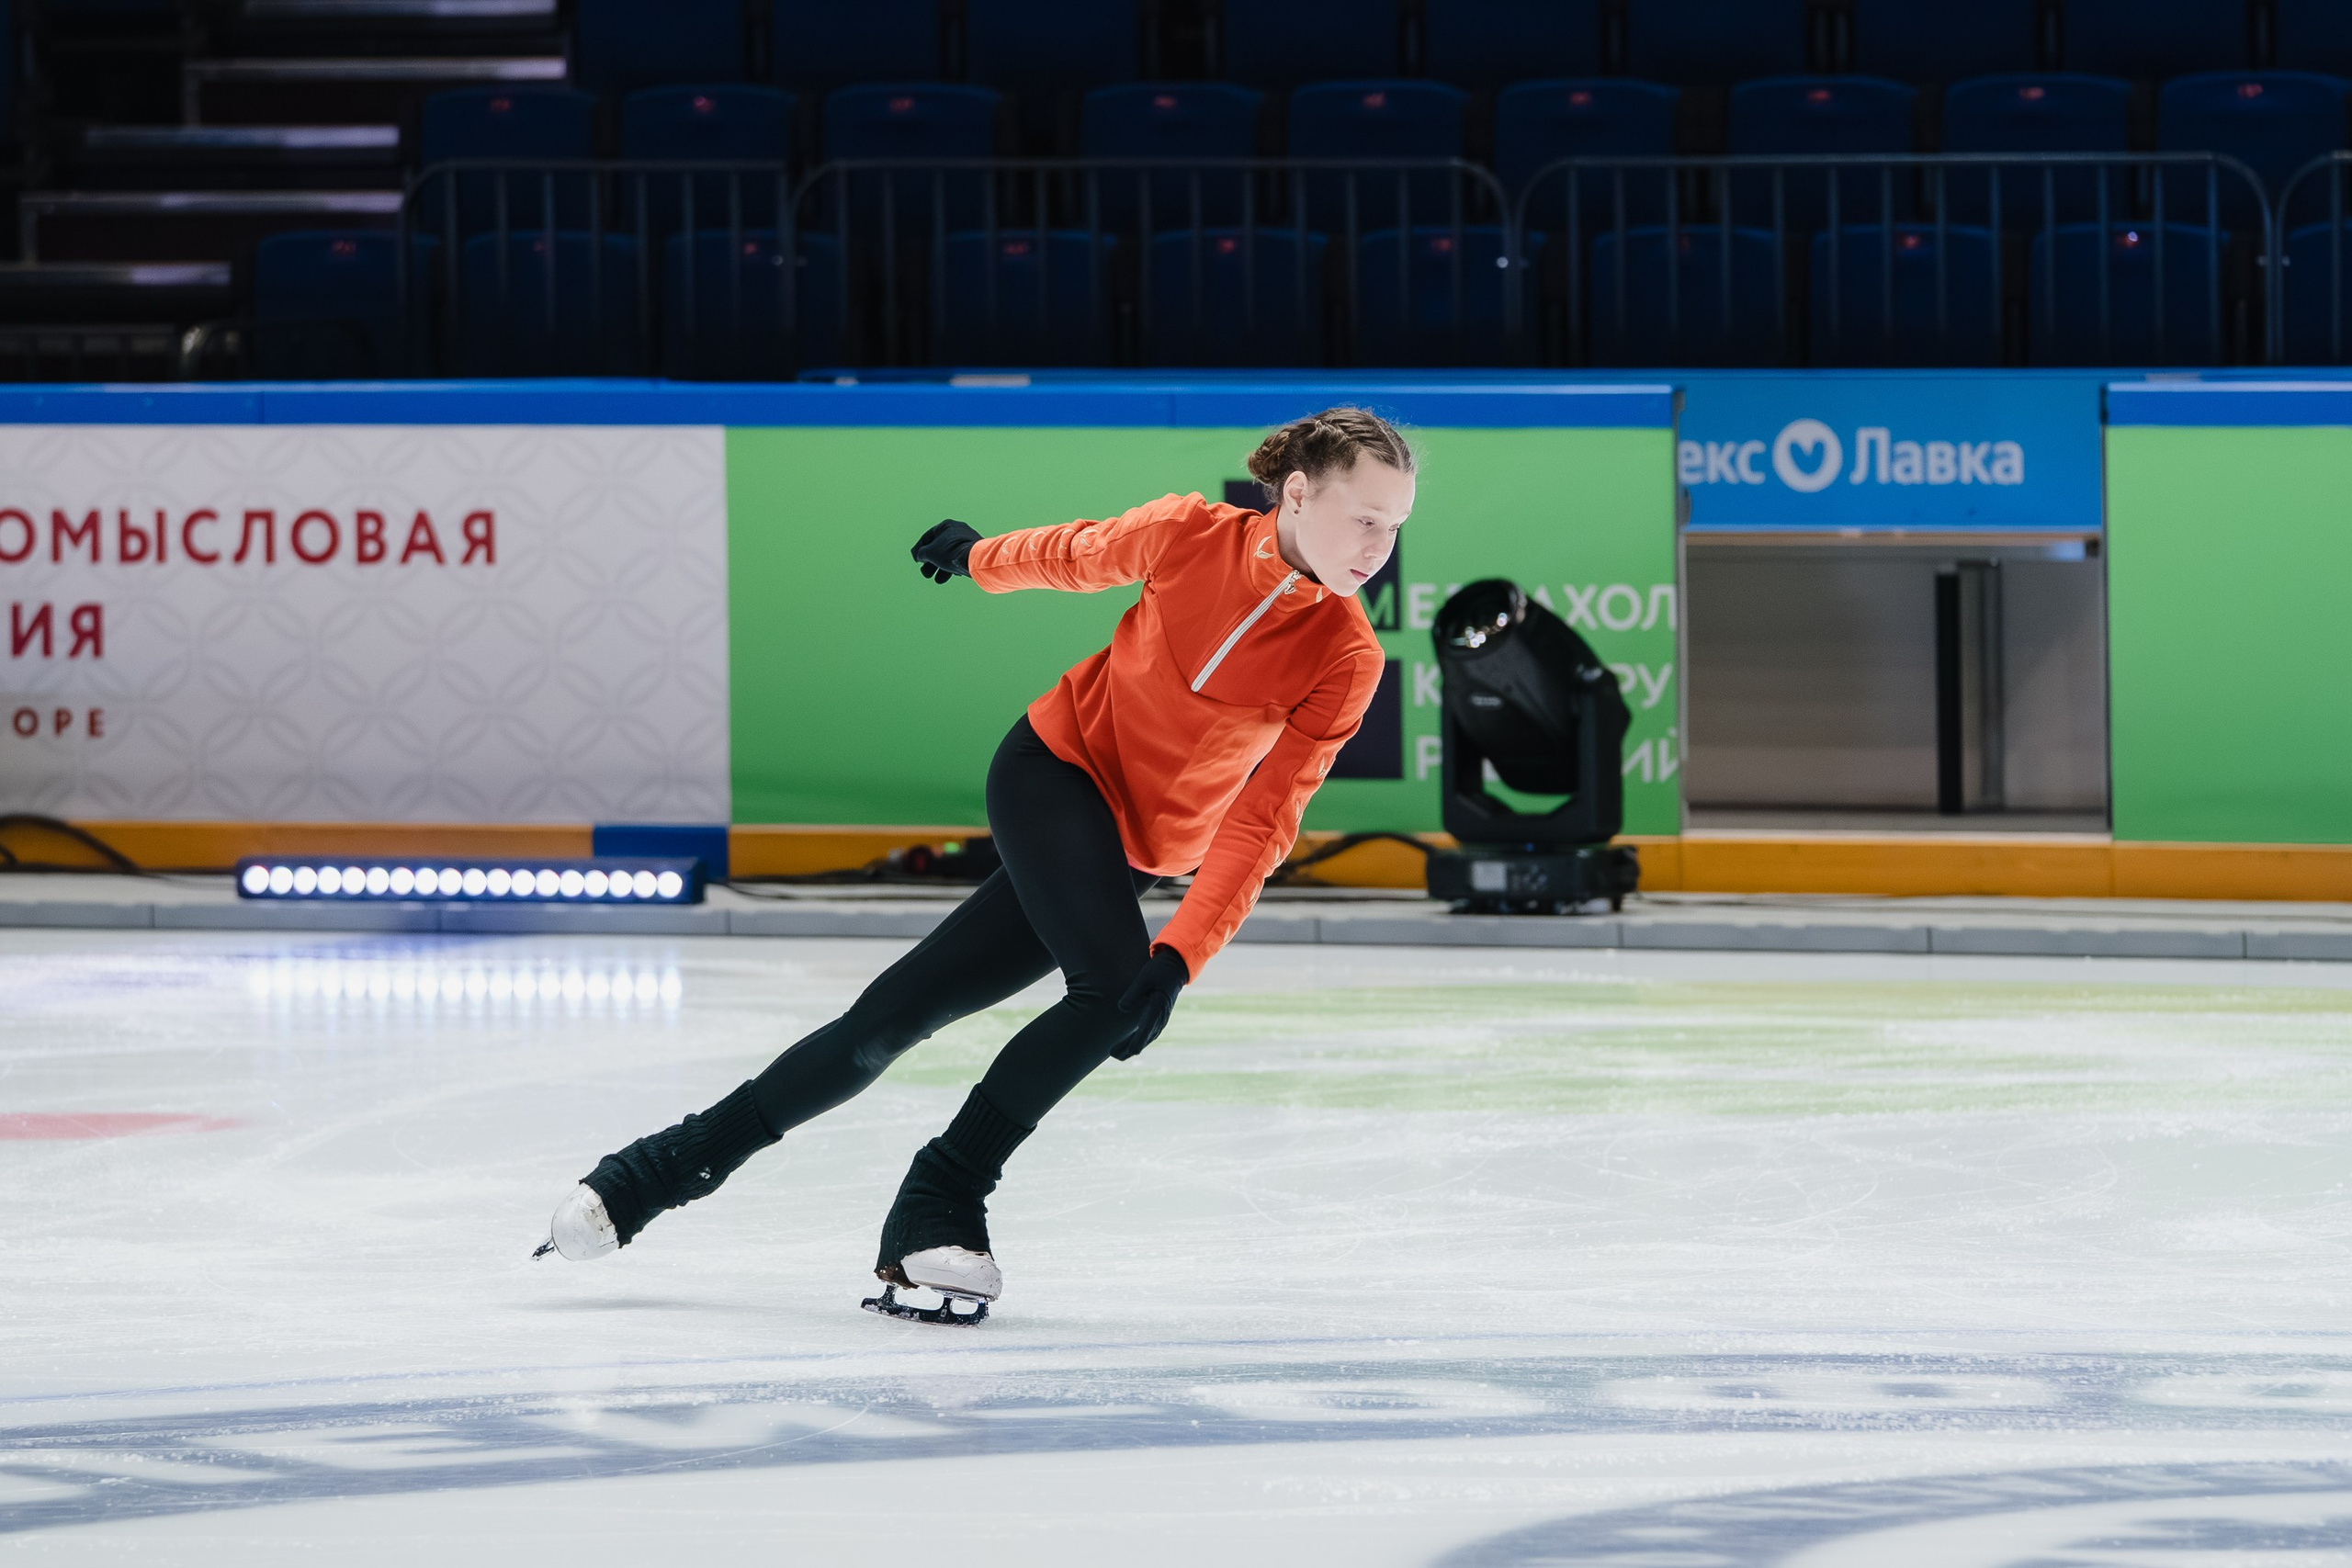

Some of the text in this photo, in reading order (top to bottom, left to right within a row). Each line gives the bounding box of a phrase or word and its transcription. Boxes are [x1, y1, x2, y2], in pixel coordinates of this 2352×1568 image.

[1678, 427, 2025, 486] екс Лавка
[0, 509, 496, 566] ОМЫСЛОВАЯ
[11, 603, 104, 659] ИЯ
[13, 707, 104, 739] ОРЕ
